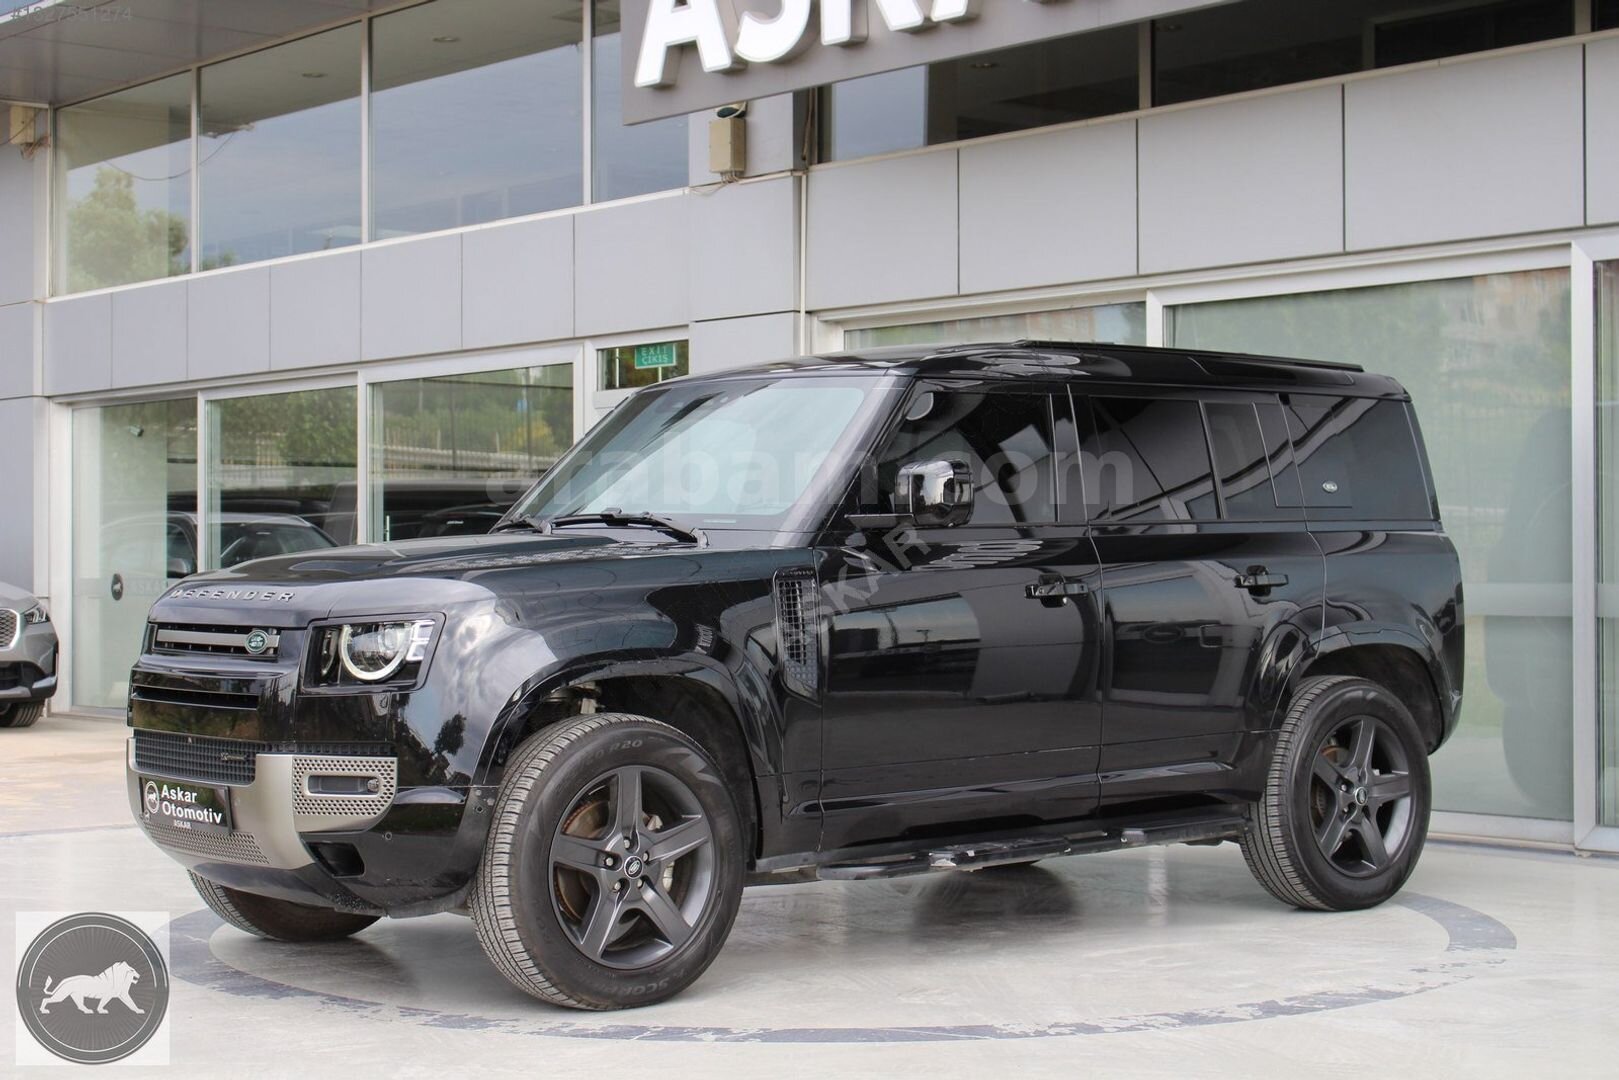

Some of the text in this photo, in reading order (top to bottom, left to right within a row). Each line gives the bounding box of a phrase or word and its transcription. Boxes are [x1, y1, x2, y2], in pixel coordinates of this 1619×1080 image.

[641, 345, 668, 357] EXIT
[169, 588, 296, 604] DEFENDER
[161, 784, 198, 803] Askar
[162, 801, 223, 825] Otomotiv
